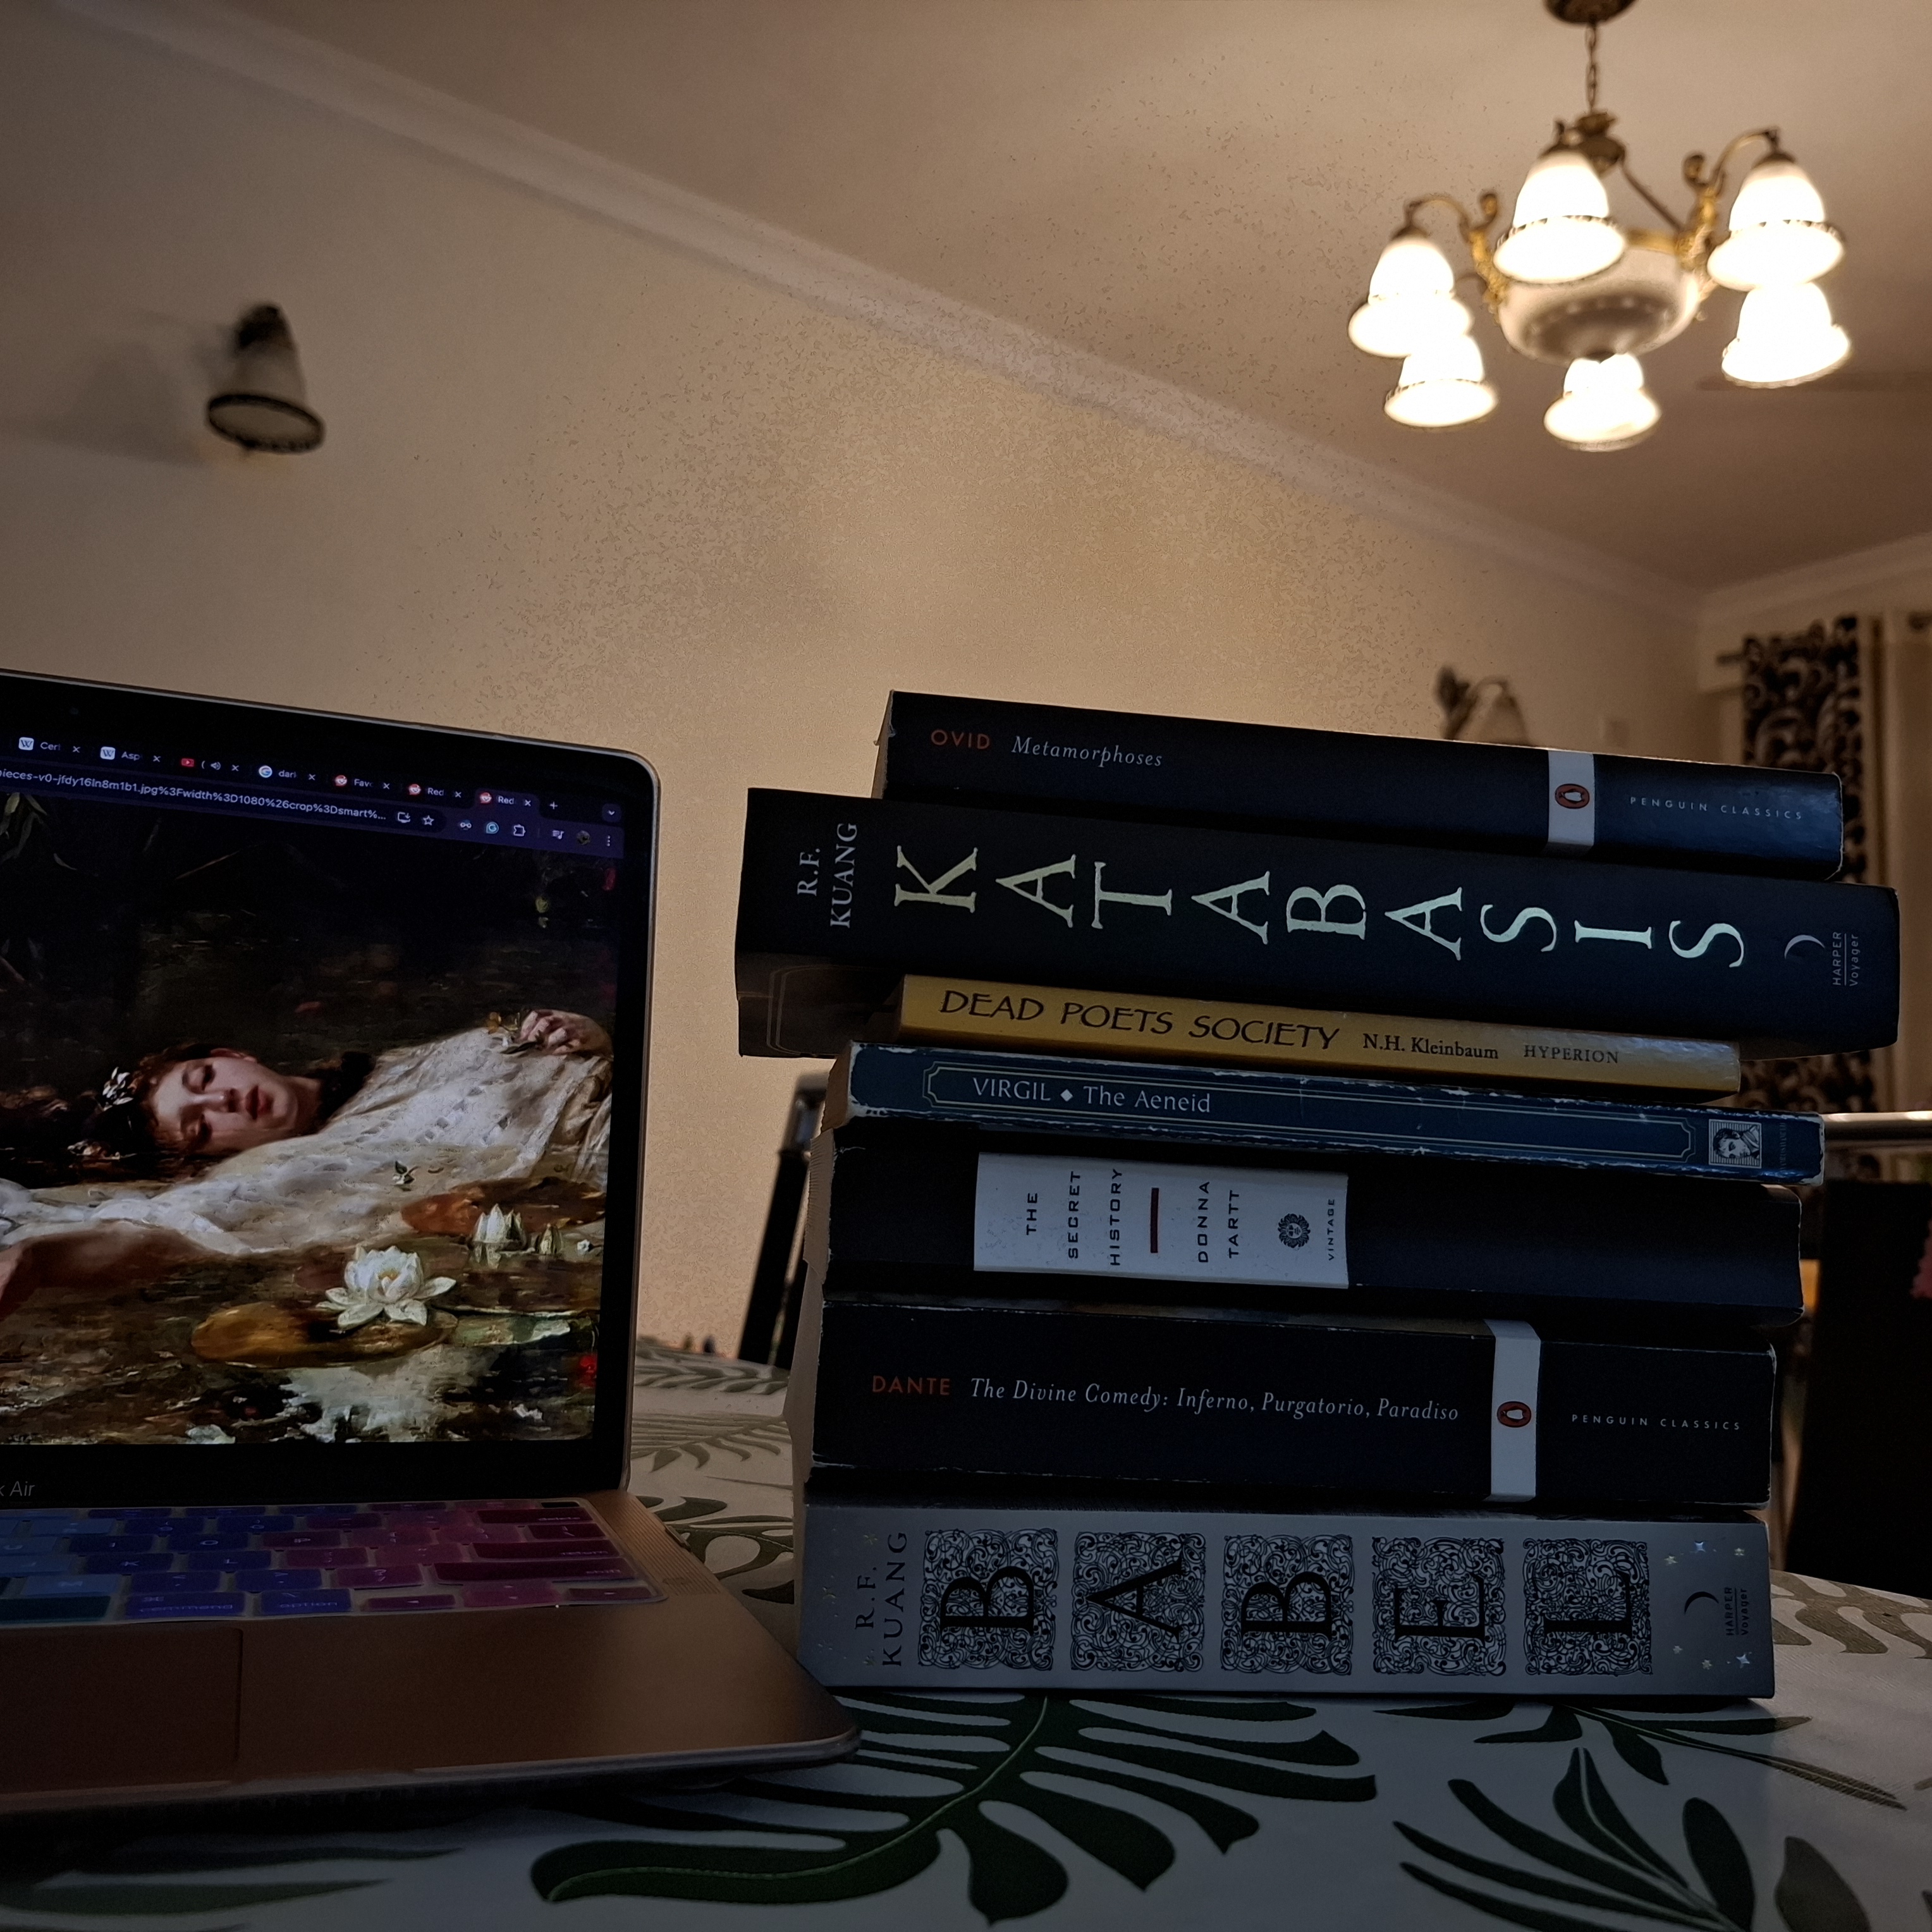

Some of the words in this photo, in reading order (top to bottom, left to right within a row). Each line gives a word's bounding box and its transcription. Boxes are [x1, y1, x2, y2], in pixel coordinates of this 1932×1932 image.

[121, 751, 140, 761] Asp
[931, 730, 991, 750] OVID
[1012, 736, 1161, 767] Metamorphoses
[498, 795, 515, 805] Red
[1630, 797, 1707, 811] PENGUIN
[1720, 804, 1802, 820] CLASSICS
[797, 849, 819, 895] R.F.
[831, 824, 857, 927] KUANG
[894, 845, 1744, 969] KATABASIS
[1833, 932, 1842, 985] HARPER
[1850, 935, 1860, 986] Voyager
[940, 989, 1045, 1021] DEAD
[1061, 1003, 1172, 1034] POETS
[1188, 1015, 1340, 1051] SOCIETY
[1363, 1033, 1405, 1051] N.H.
[1411, 1037, 1499, 1060] Kleinbaum
[1524, 1044, 1619, 1065] HYPERION
[972, 1077, 1051, 1102] VIRGIL
[1084, 1085, 1125, 1106] The
[1134, 1091, 1211, 1113] Aeneid
[1027, 1194, 1037, 1235] THE
[1068, 1171, 1080, 1258] SECRET
[1110, 1168, 1122, 1265] HISTORY
[1198, 1182, 1209, 1263] DONNA
[1228, 1190, 1239, 1258] TARTT
[874, 1376, 949, 1395] DANTE
[972, 1378, 1004, 1398] The
[1013, 1380, 1076, 1401] Divine
[1085, 1383, 1167, 1412] Comedy:
[1178, 1388, 1254, 1414] Inferno,
[1262, 1392, 1369, 1419] Purgatorio,
[1378, 1398, 1458, 1420] Paradiso
[1572, 1414, 1647, 1426] PENGUIN
[1660, 1419, 1739, 1430] CLASSICS
[10, 1481, 35, 1496] Air
[855, 1567, 876, 1629] R.F.
[883, 1533, 907, 1666] KUANG
[940, 1555, 1634, 1645] BABEL
[1725, 1587, 1735, 1636] HARPER
[1740, 1588, 1751, 1636] Voyager
